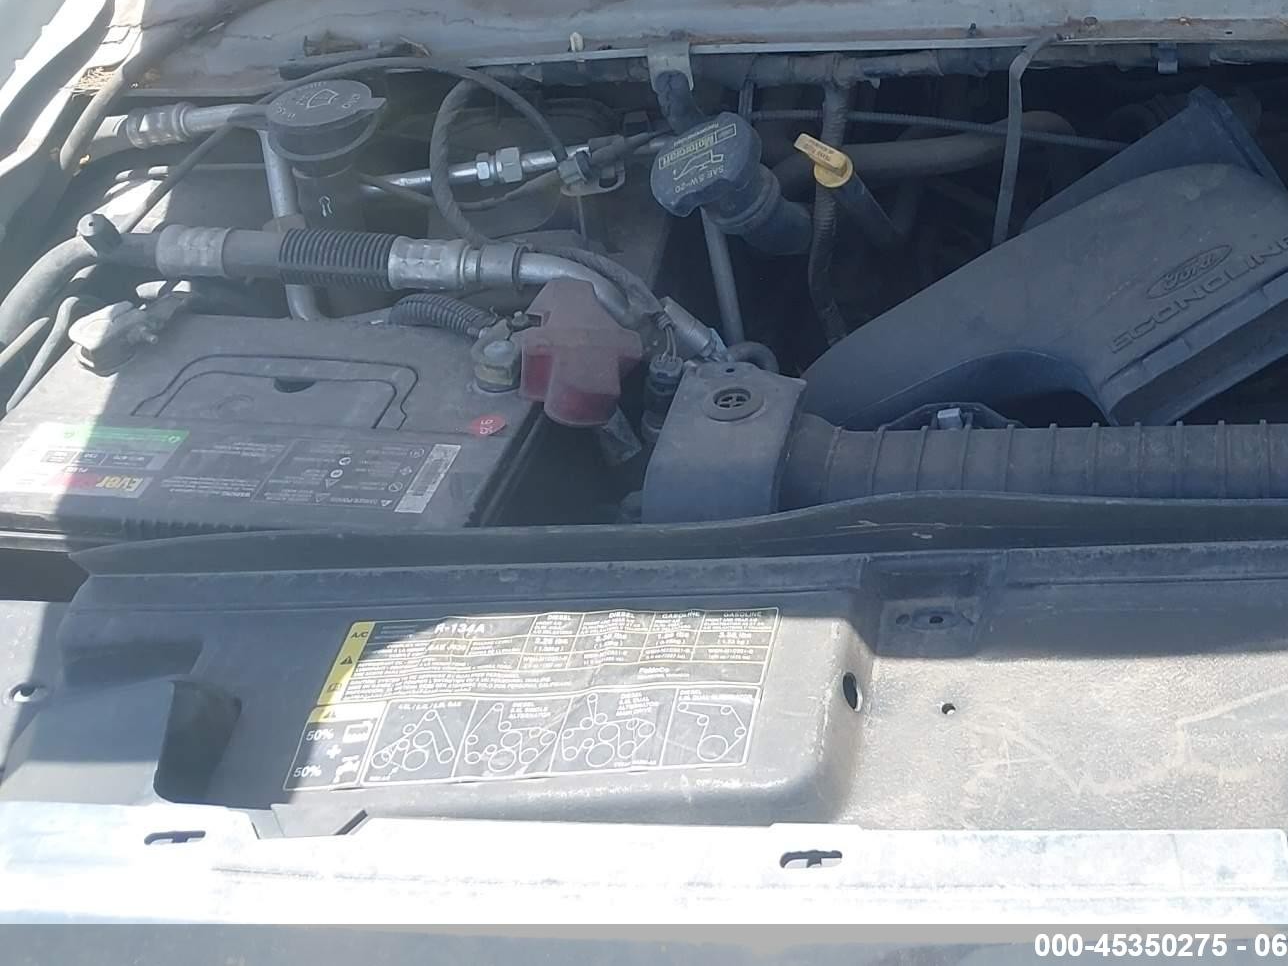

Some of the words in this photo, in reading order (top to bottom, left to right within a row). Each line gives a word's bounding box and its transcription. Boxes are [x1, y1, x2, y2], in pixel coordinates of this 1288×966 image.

[434, 622, 486, 635] R-134A
[306, 728, 334, 741] 50%
[293, 764, 322, 778] 50%
